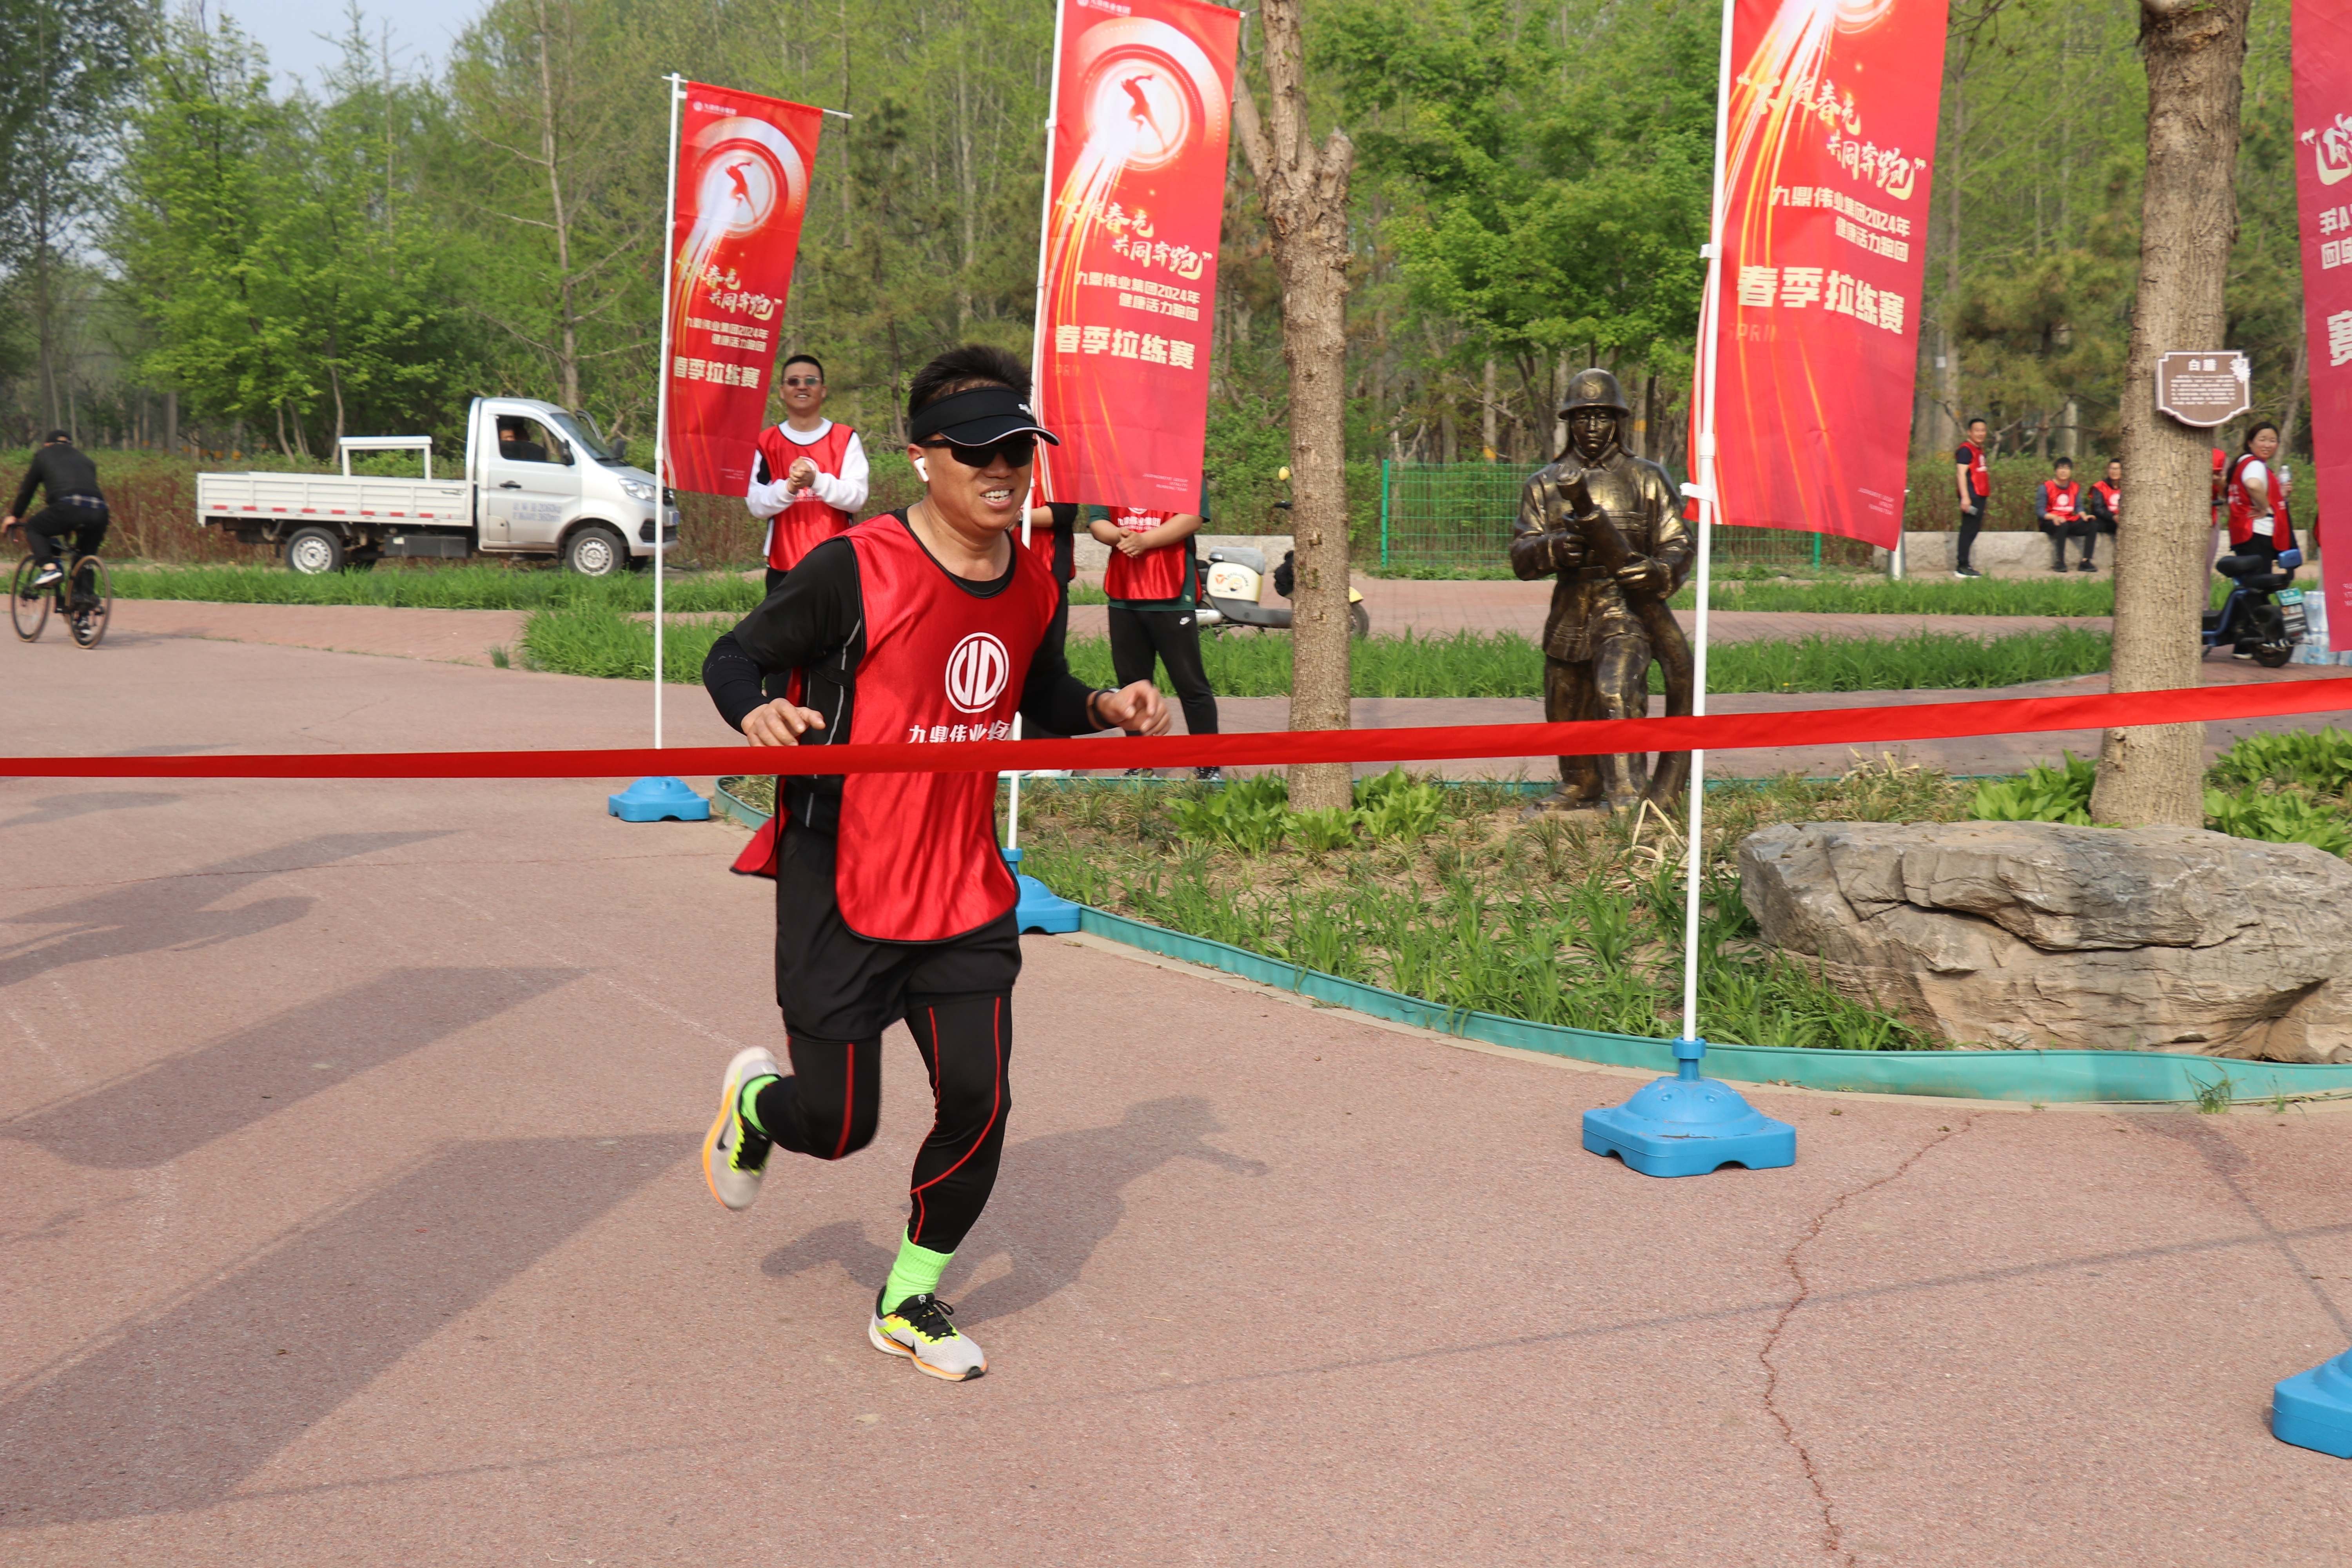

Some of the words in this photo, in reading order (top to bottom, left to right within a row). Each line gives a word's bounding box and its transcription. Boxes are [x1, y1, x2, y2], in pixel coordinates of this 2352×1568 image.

[1770, 185, 1911, 237] 九鼎伟业集团2024年
[1835, 216, 1909, 262] 健康活力跑团
[1075, 271, 1201, 304] 九鼎伟业集团2024年
[1119, 292, 1199, 321] 健康活力跑团
[1737, 265, 1905, 335] 春季拉练赛
[1054, 324, 1195, 370] 春季拉练赛
[674, 355, 761, 388] 春季拉练赛
